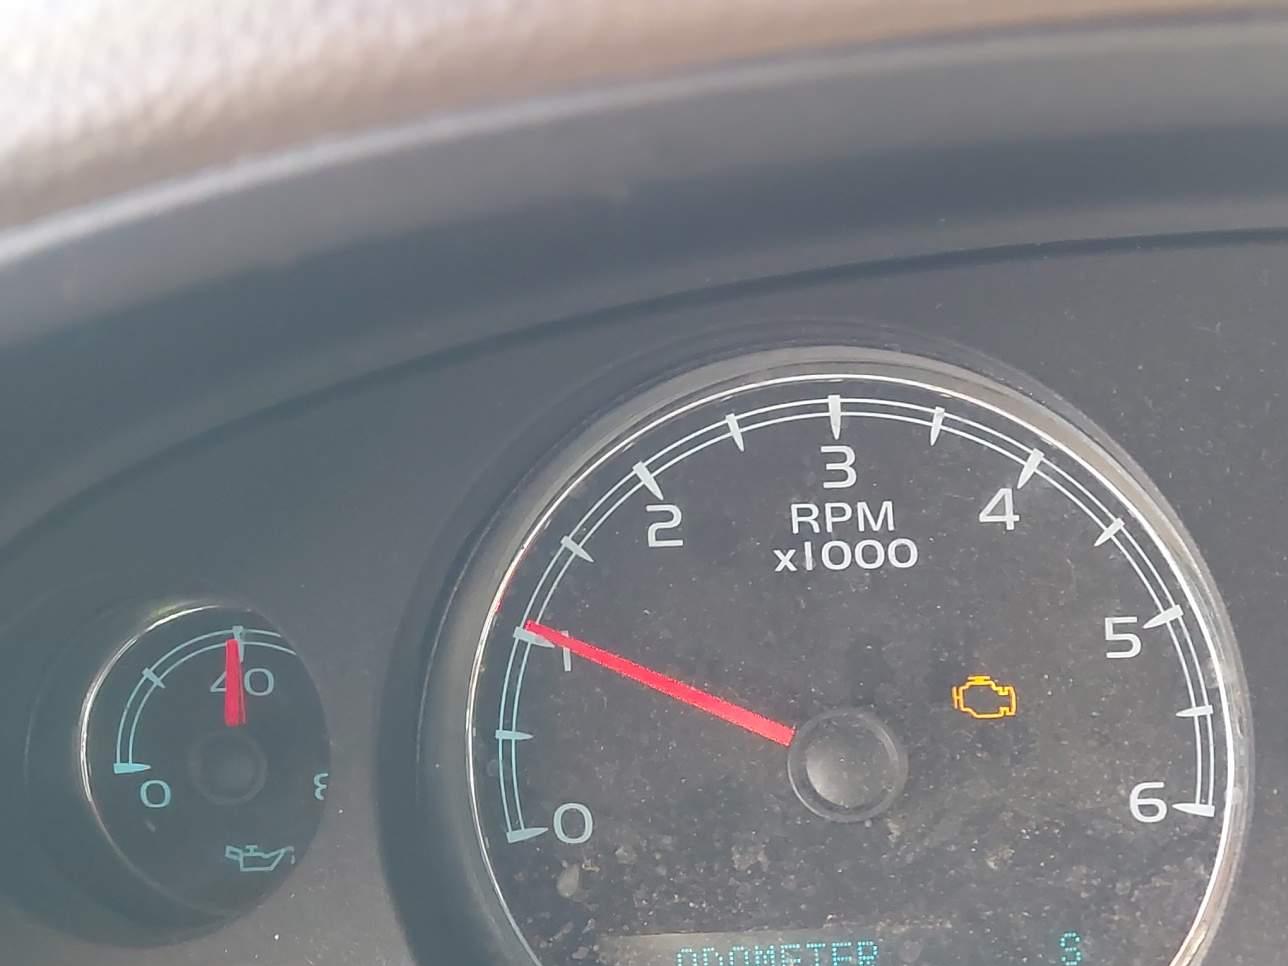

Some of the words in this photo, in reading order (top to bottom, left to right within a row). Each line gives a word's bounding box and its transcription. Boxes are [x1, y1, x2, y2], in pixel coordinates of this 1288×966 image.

[820, 446, 857, 488] 3
[646, 504, 685, 548] 2
[791, 501, 895, 534] RPM
[979, 488, 1020, 530] 4
[1104, 617, 1143, 659] 5
[139, 779, 172, 809] 0
[1130, 781, 1166, 823] 6
[553, 803, 593, 844] 0
[1060, 932, 1081, 966] S
